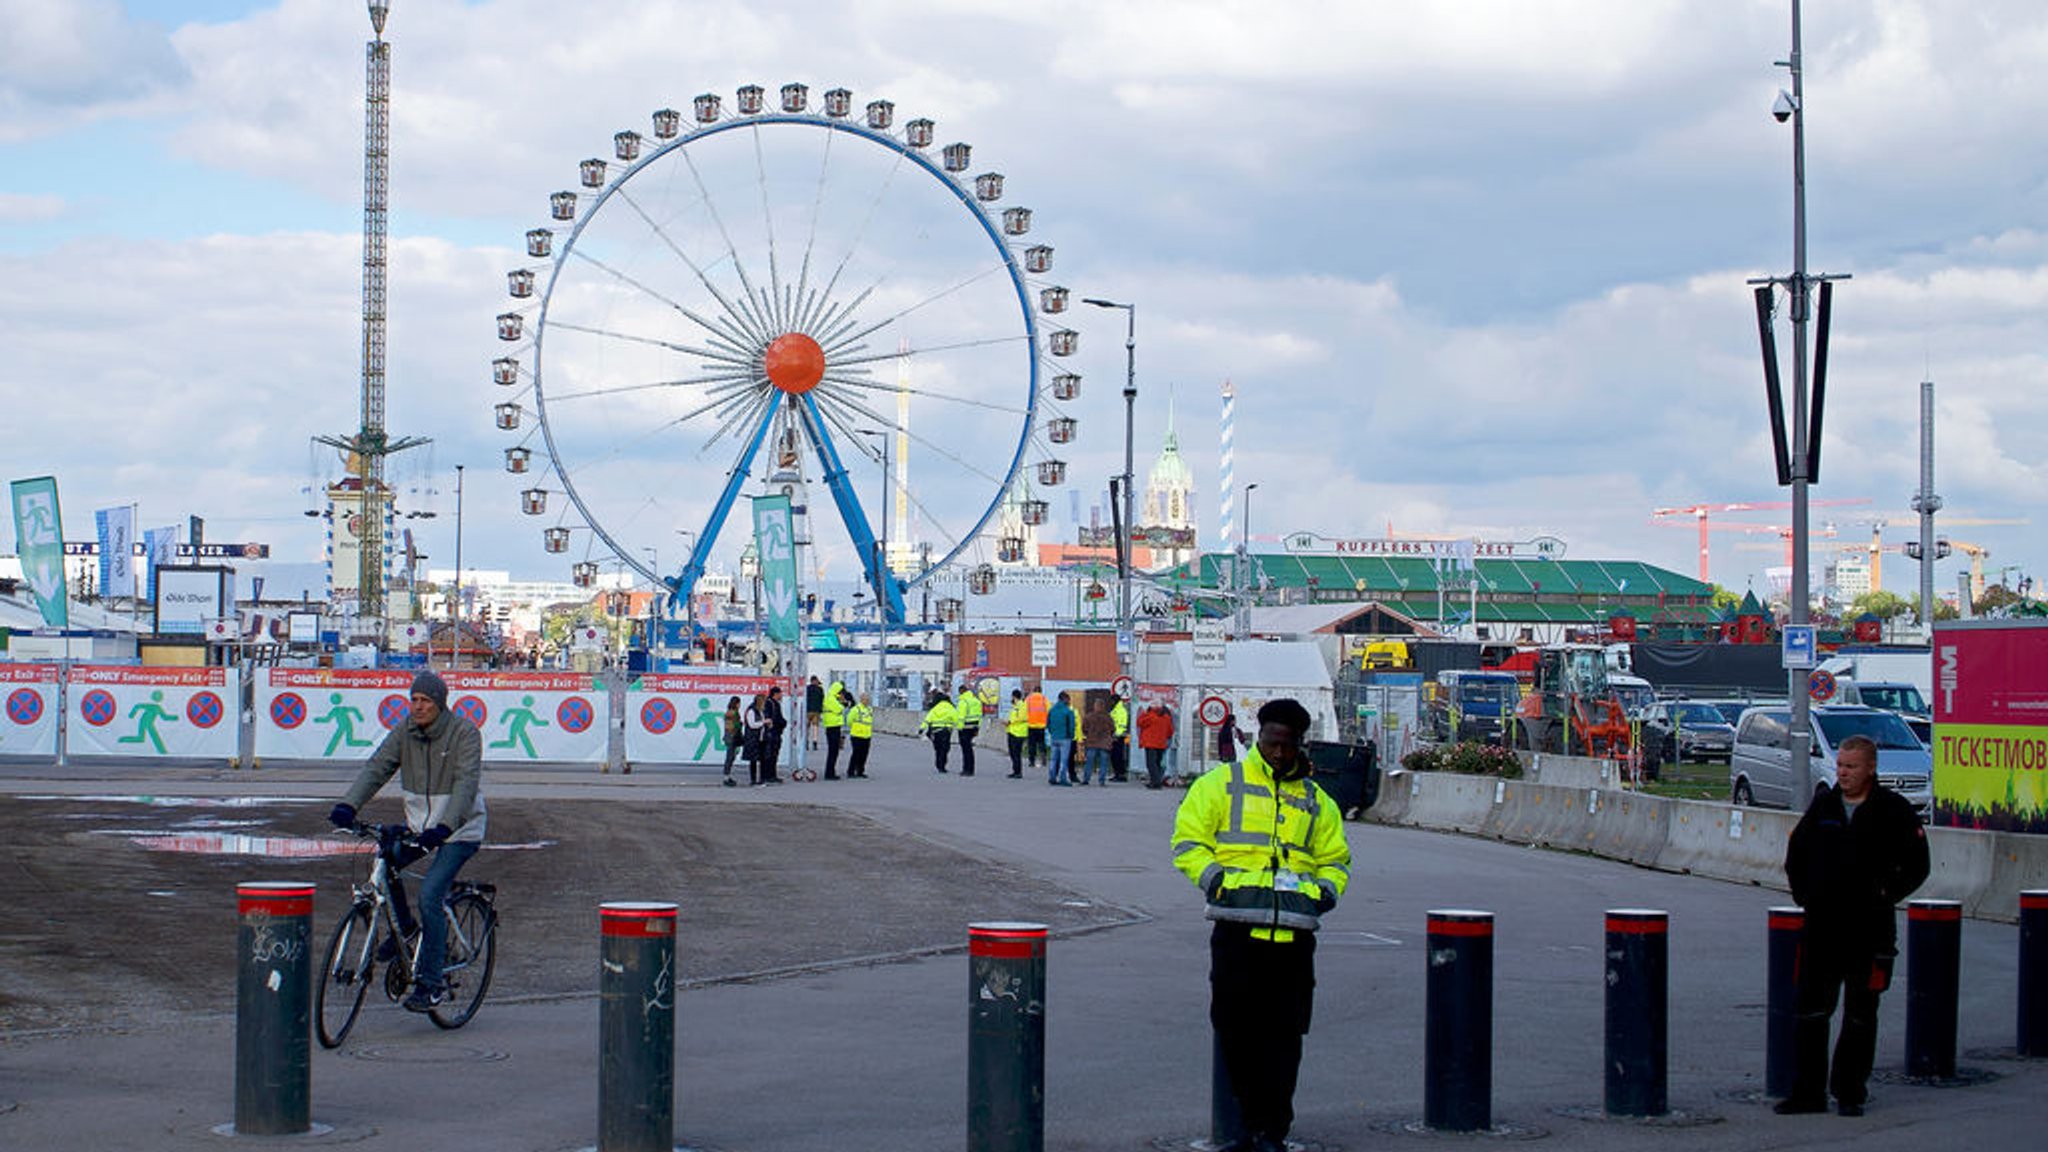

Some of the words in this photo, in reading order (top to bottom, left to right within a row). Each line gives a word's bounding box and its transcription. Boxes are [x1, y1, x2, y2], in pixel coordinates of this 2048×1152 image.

[1336, 541, 1422, 553] KUFFLERS
[15, 670, 33, 680] Exit
[91, 671, 120, 681] ONLY
[122, 672, 179, 683] Emergency
[183, 672, 201, 682] Exit
[292, 674, 322, 684] ONLY
[326, 676, 382, 687] Emergency
[461, 678, 491, 687] ONLY
[493, 679, 550, 688] Emergency
[553, 679, 571, 687] Exit
[662, 680, 691, 690] ONLY
[693, 682, 749, 693] Emergency
[752, 683, 769, 691] Exit
[1941, 736, 2047, 770] TICKETMOB
